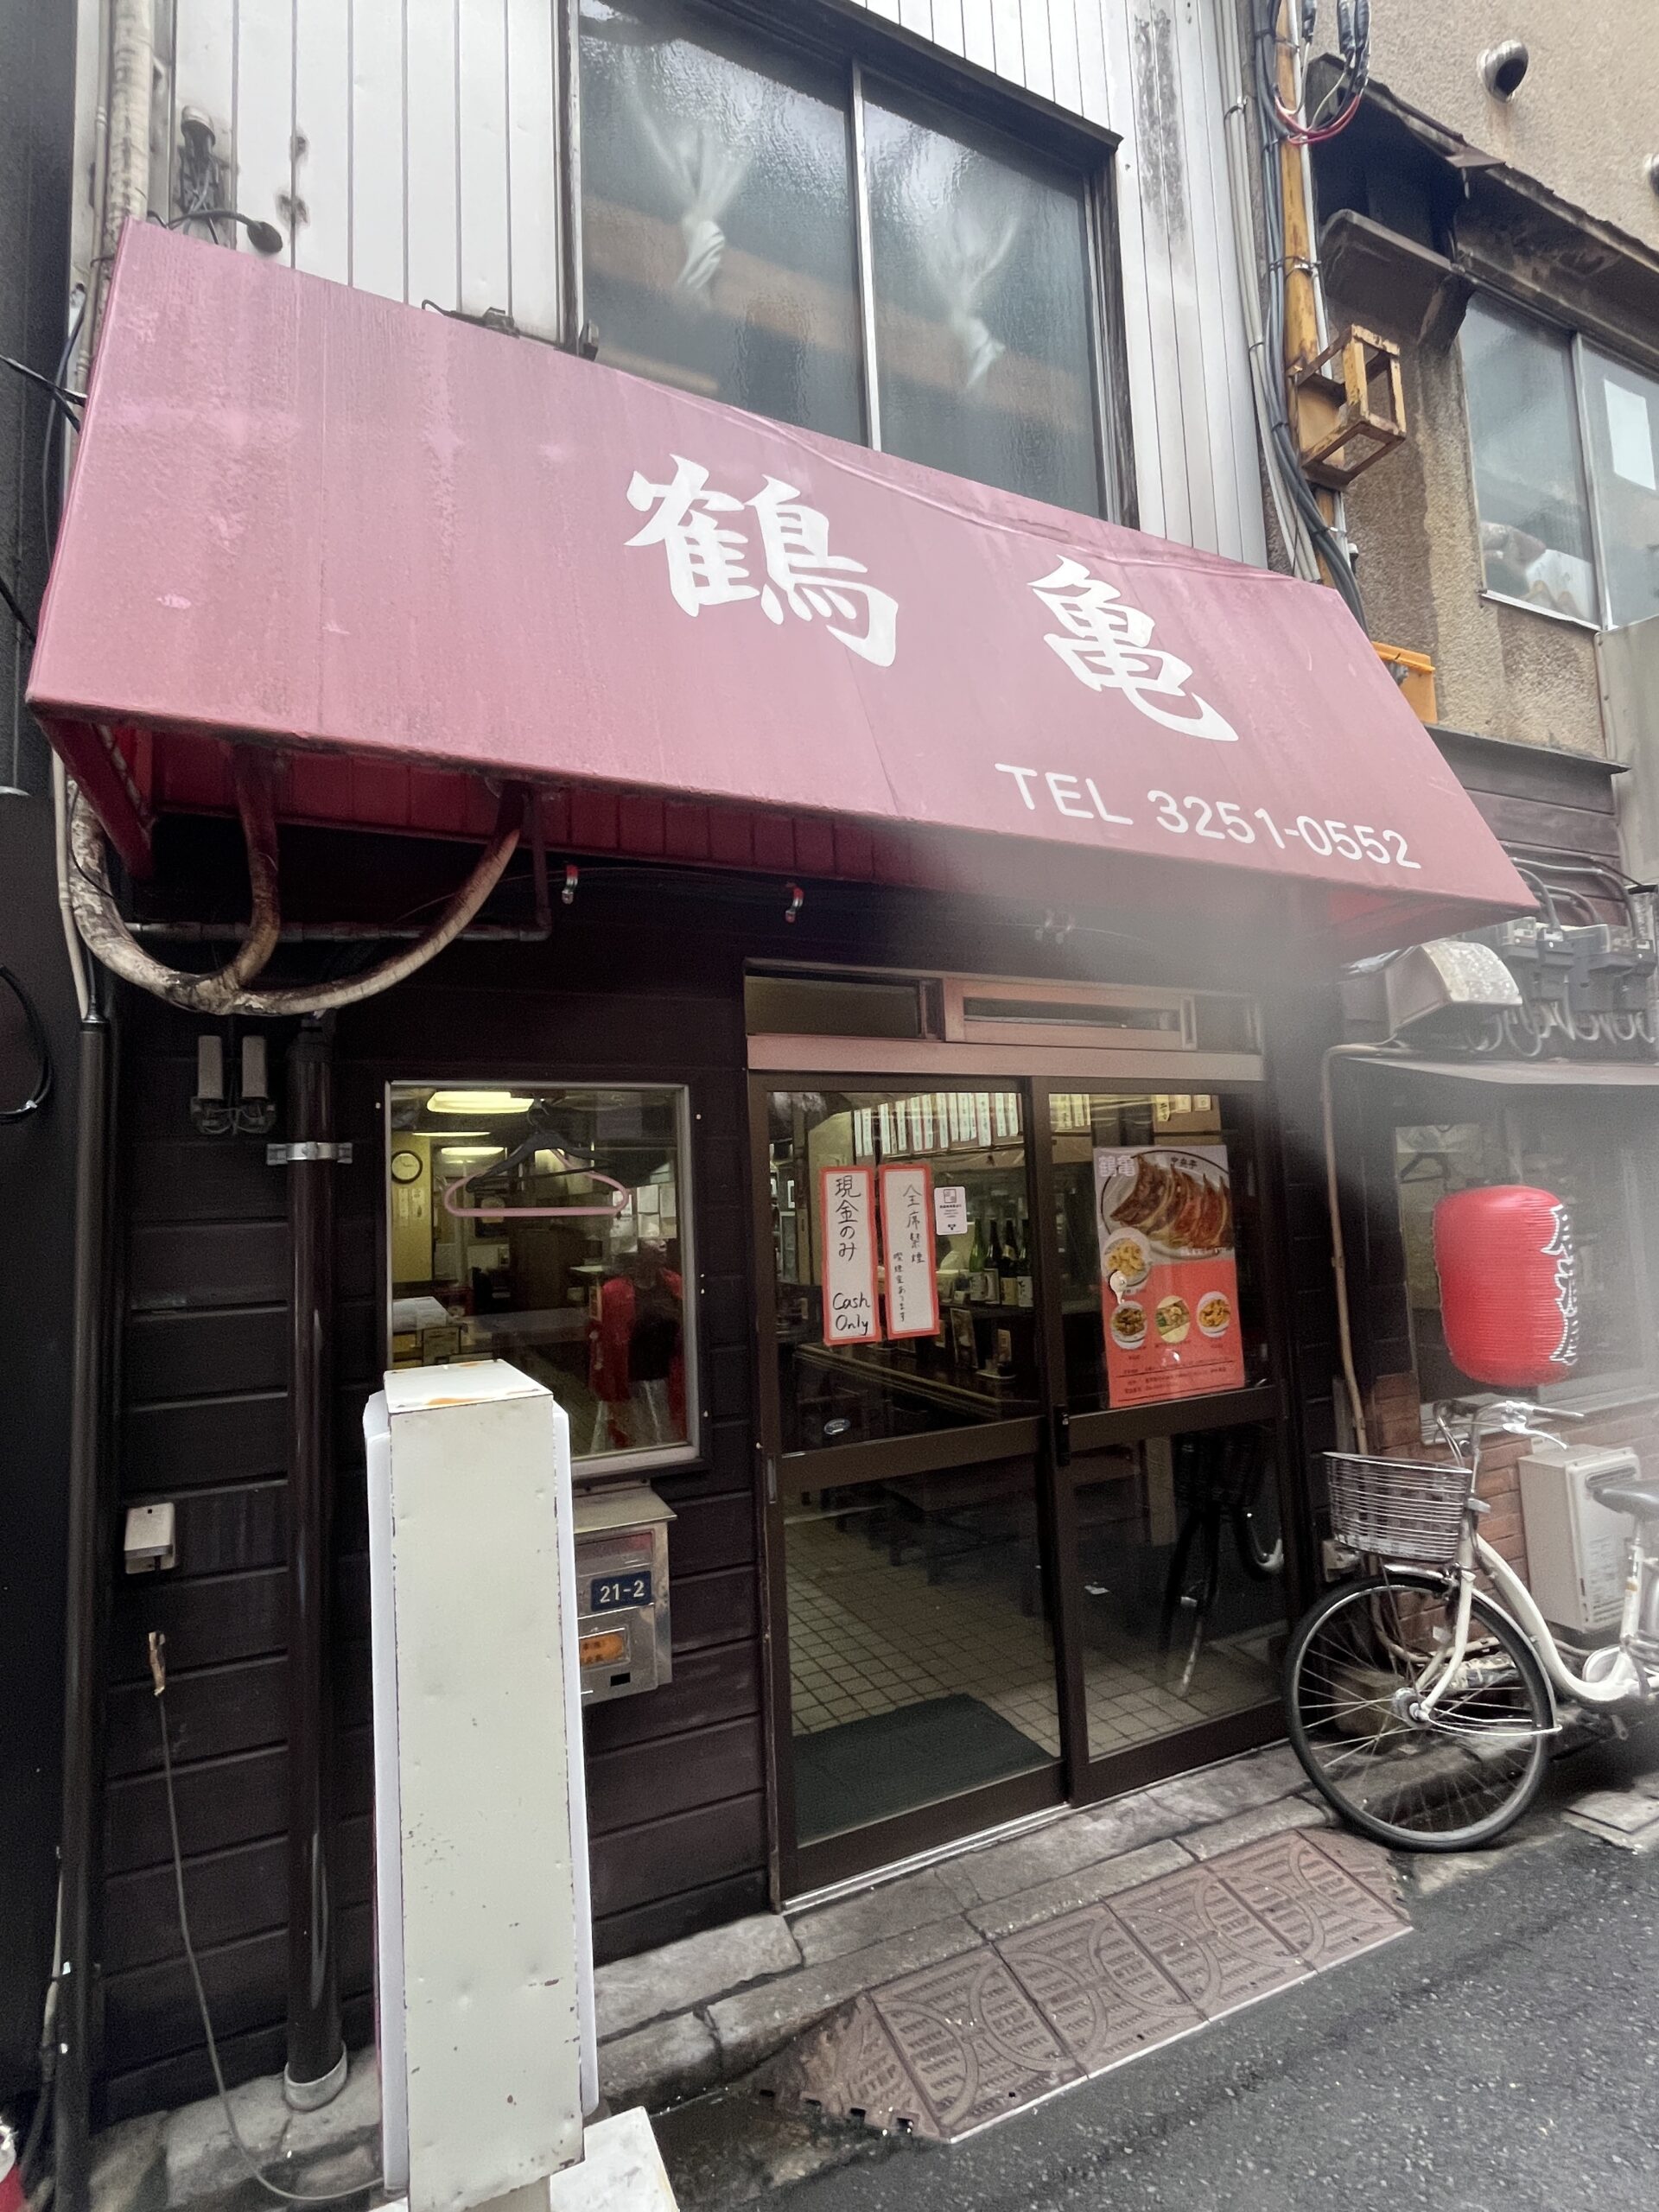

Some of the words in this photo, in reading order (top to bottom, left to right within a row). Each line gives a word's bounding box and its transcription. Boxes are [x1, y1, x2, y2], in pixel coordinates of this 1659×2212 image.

[623, 454, 1239, 741] 鶴亀
[995, 763, 1134, 825] TEL
[1147, 790, 1421, 869] 3251-0552
[1098, 1155, 1136, 1177] 鶴亀
[835, 1175, 861, 1262] 現金のみ
[832, 1293, 871, 1310] Cash
[835, 1314, 869, 1336] Only
[600, 1580, 645, 1604] 21-2
